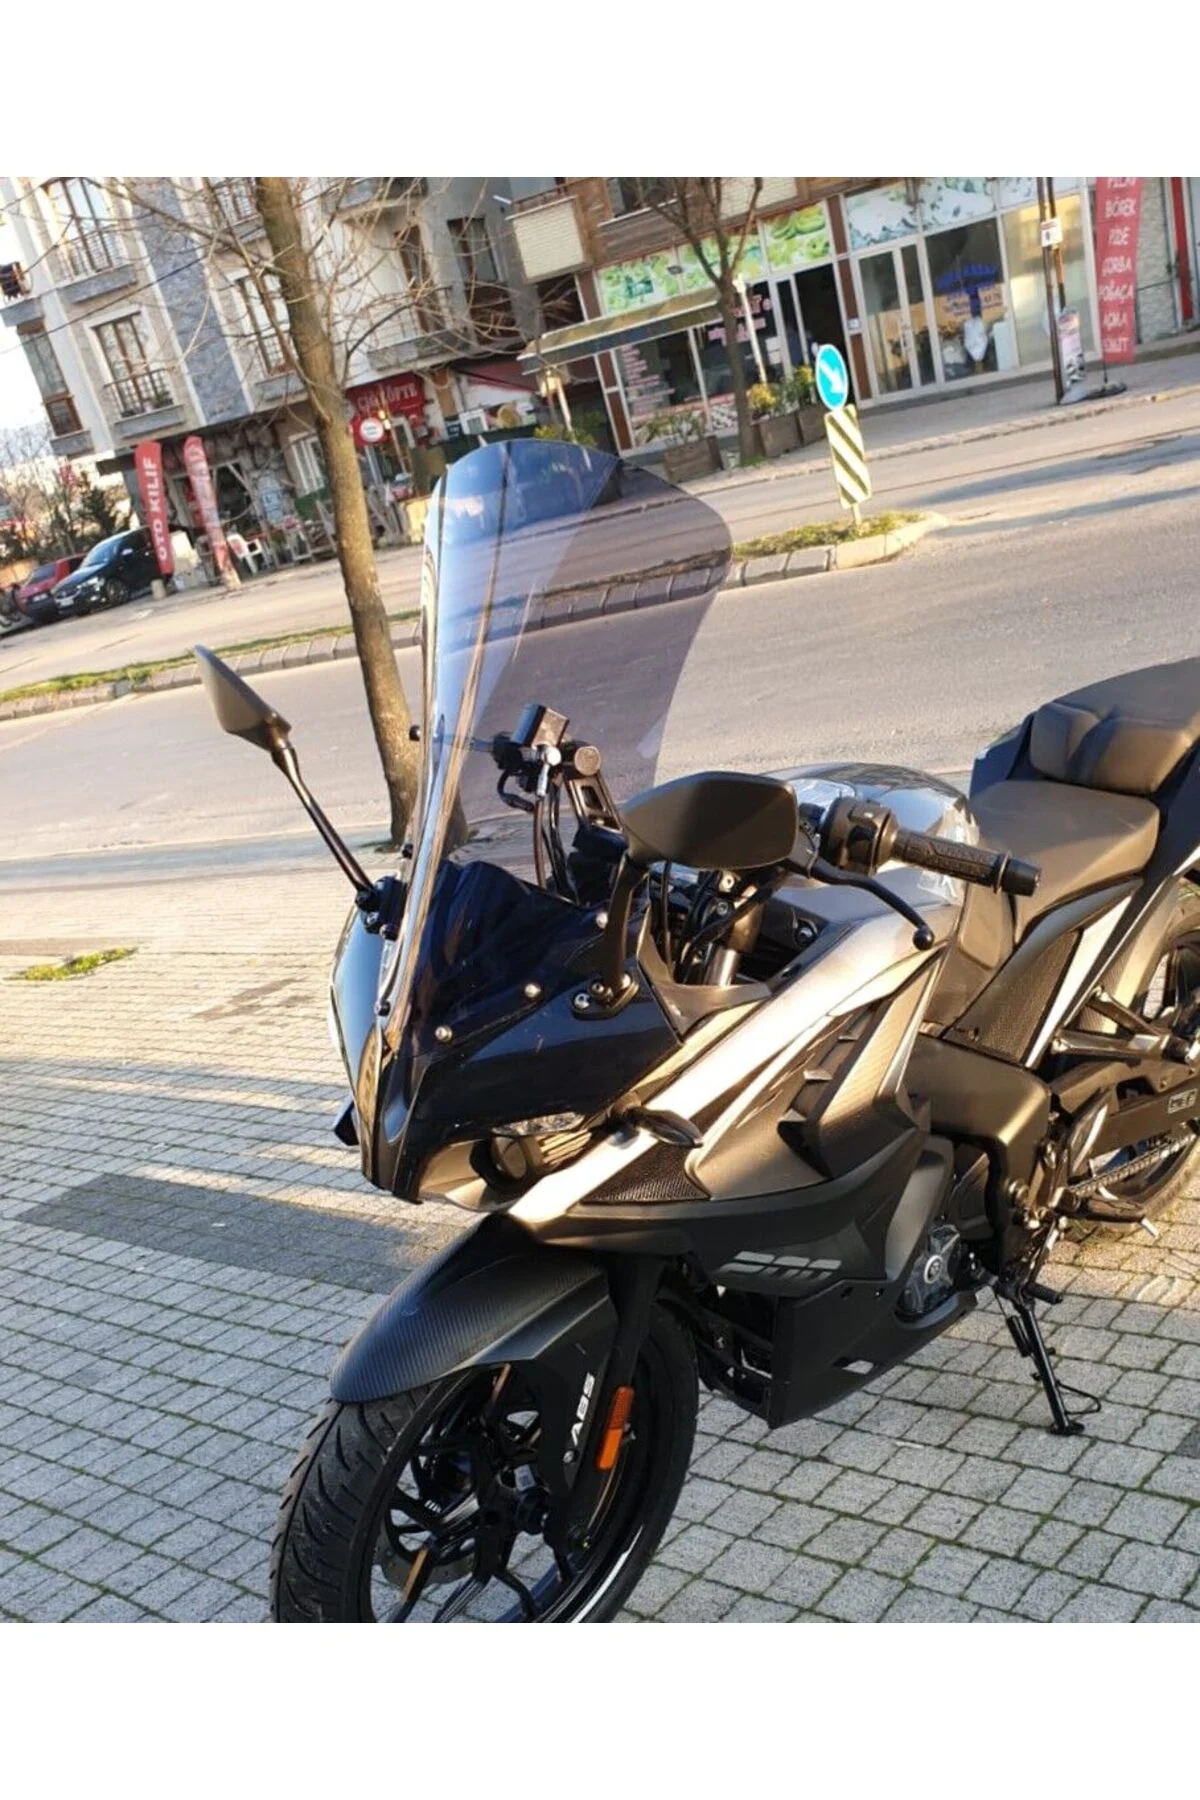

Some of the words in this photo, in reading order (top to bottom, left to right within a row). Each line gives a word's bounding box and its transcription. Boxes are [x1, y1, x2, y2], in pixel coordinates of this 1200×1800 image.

[143, 457, 161, 513] KILIF
[152, 518, 168, 561] OTO
[570, 1371, 596, 1448] ABS
